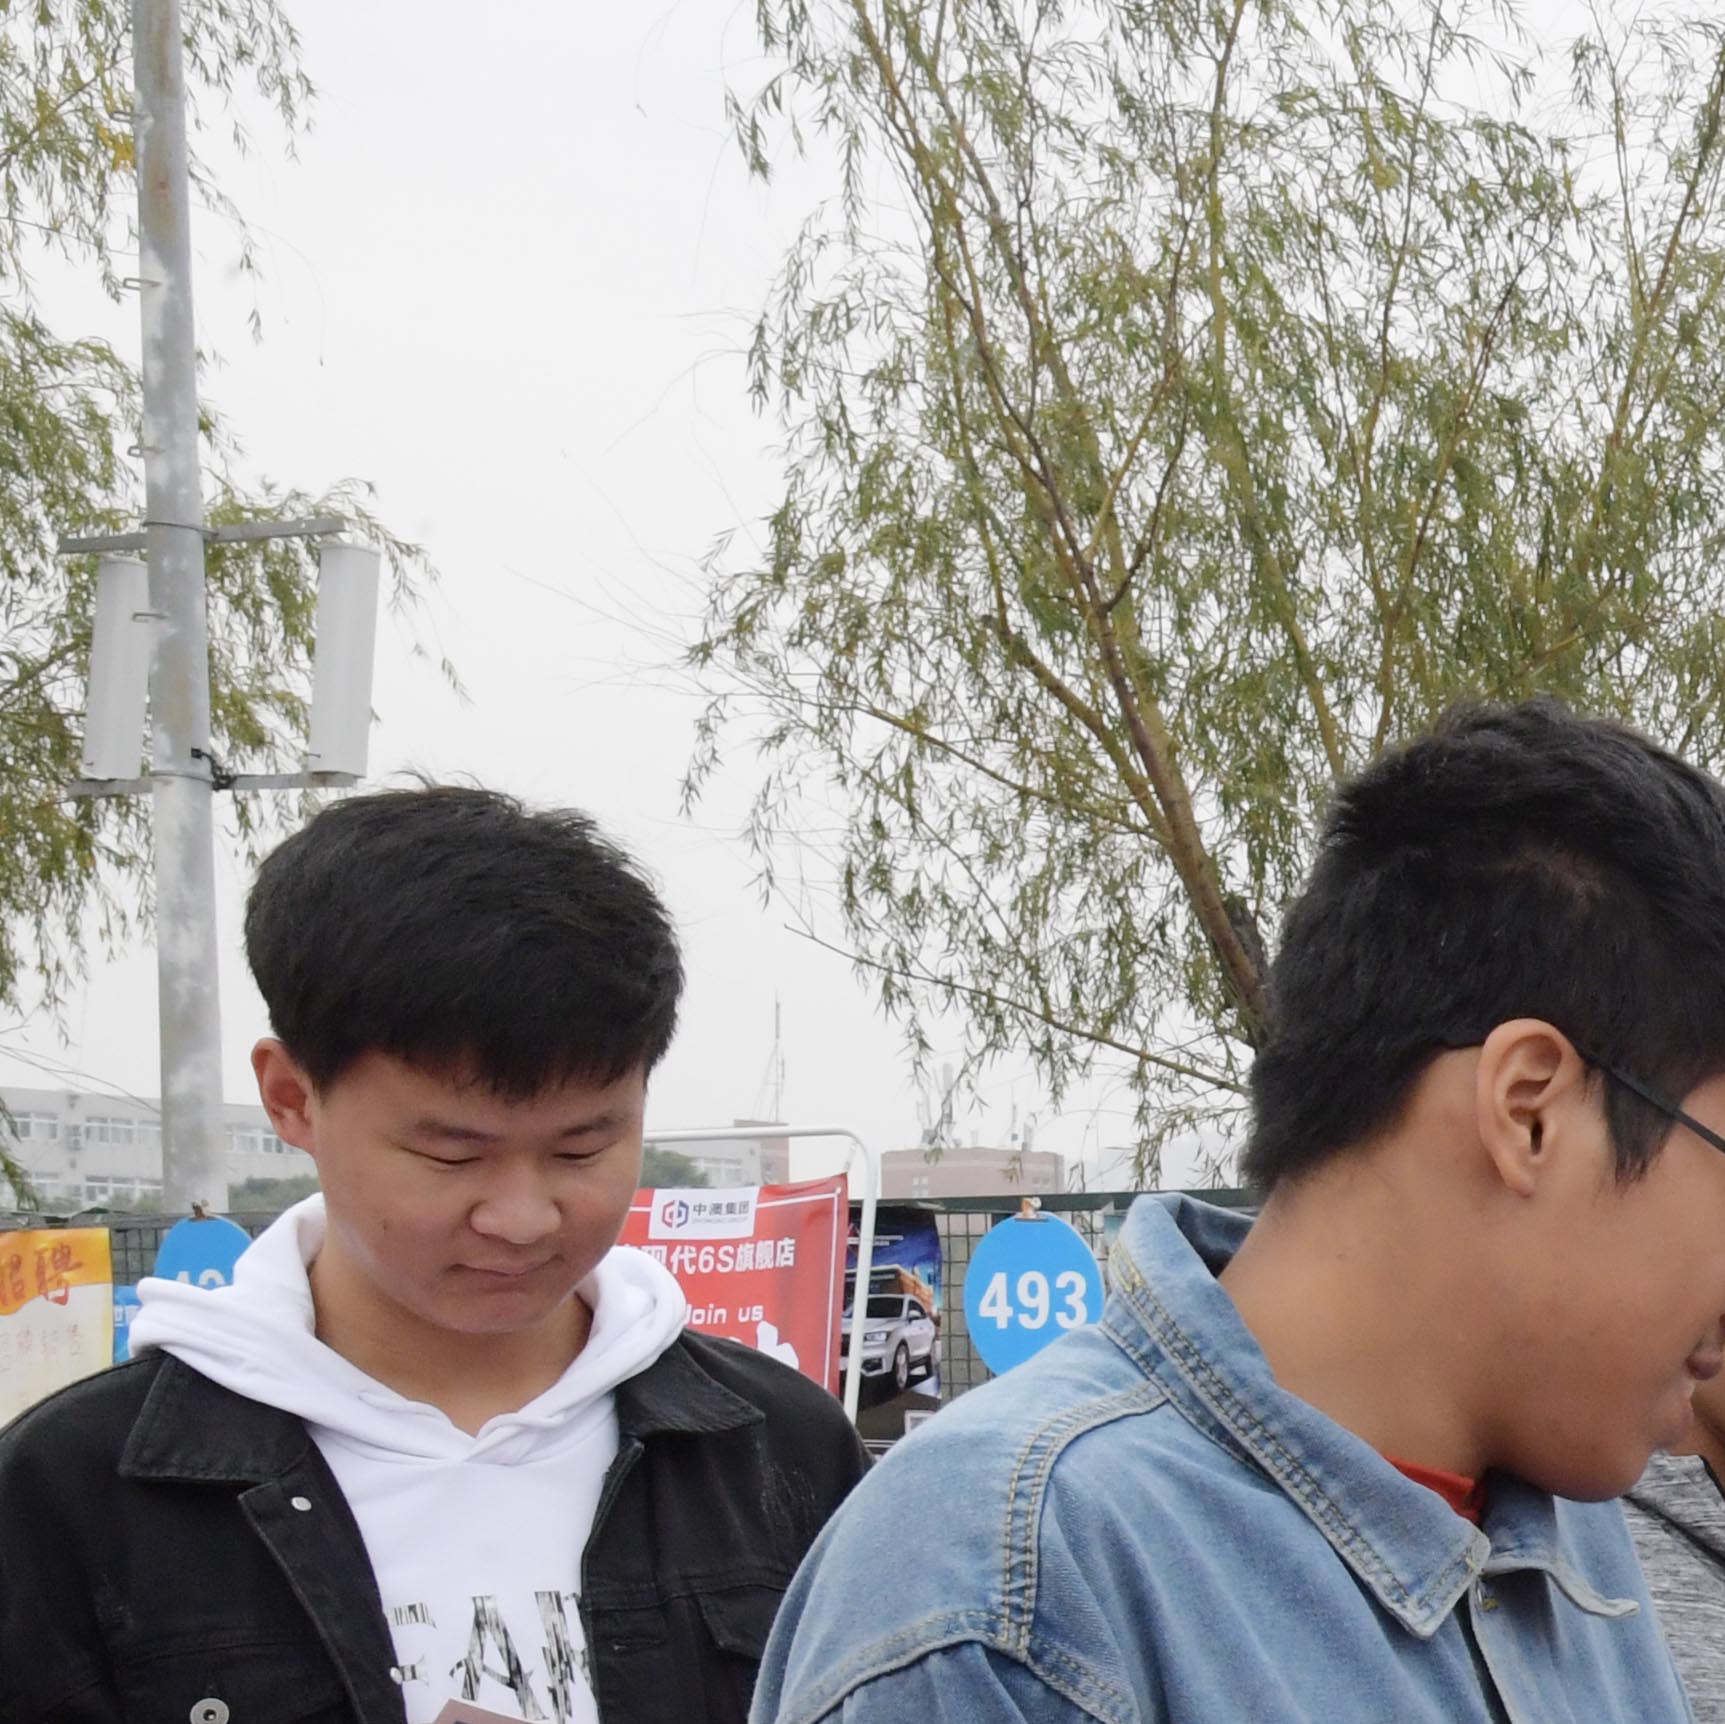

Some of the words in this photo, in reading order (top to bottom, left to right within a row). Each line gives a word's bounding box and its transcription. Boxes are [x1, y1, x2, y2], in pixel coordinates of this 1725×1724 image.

[692, 1200, 750, 1217] 中澳集团
[621, 1237, 796, 1275] 现代6S旗舰店
[738, 1305, 764, 1322] us
[979, 1271, 1087, 1329] 493
